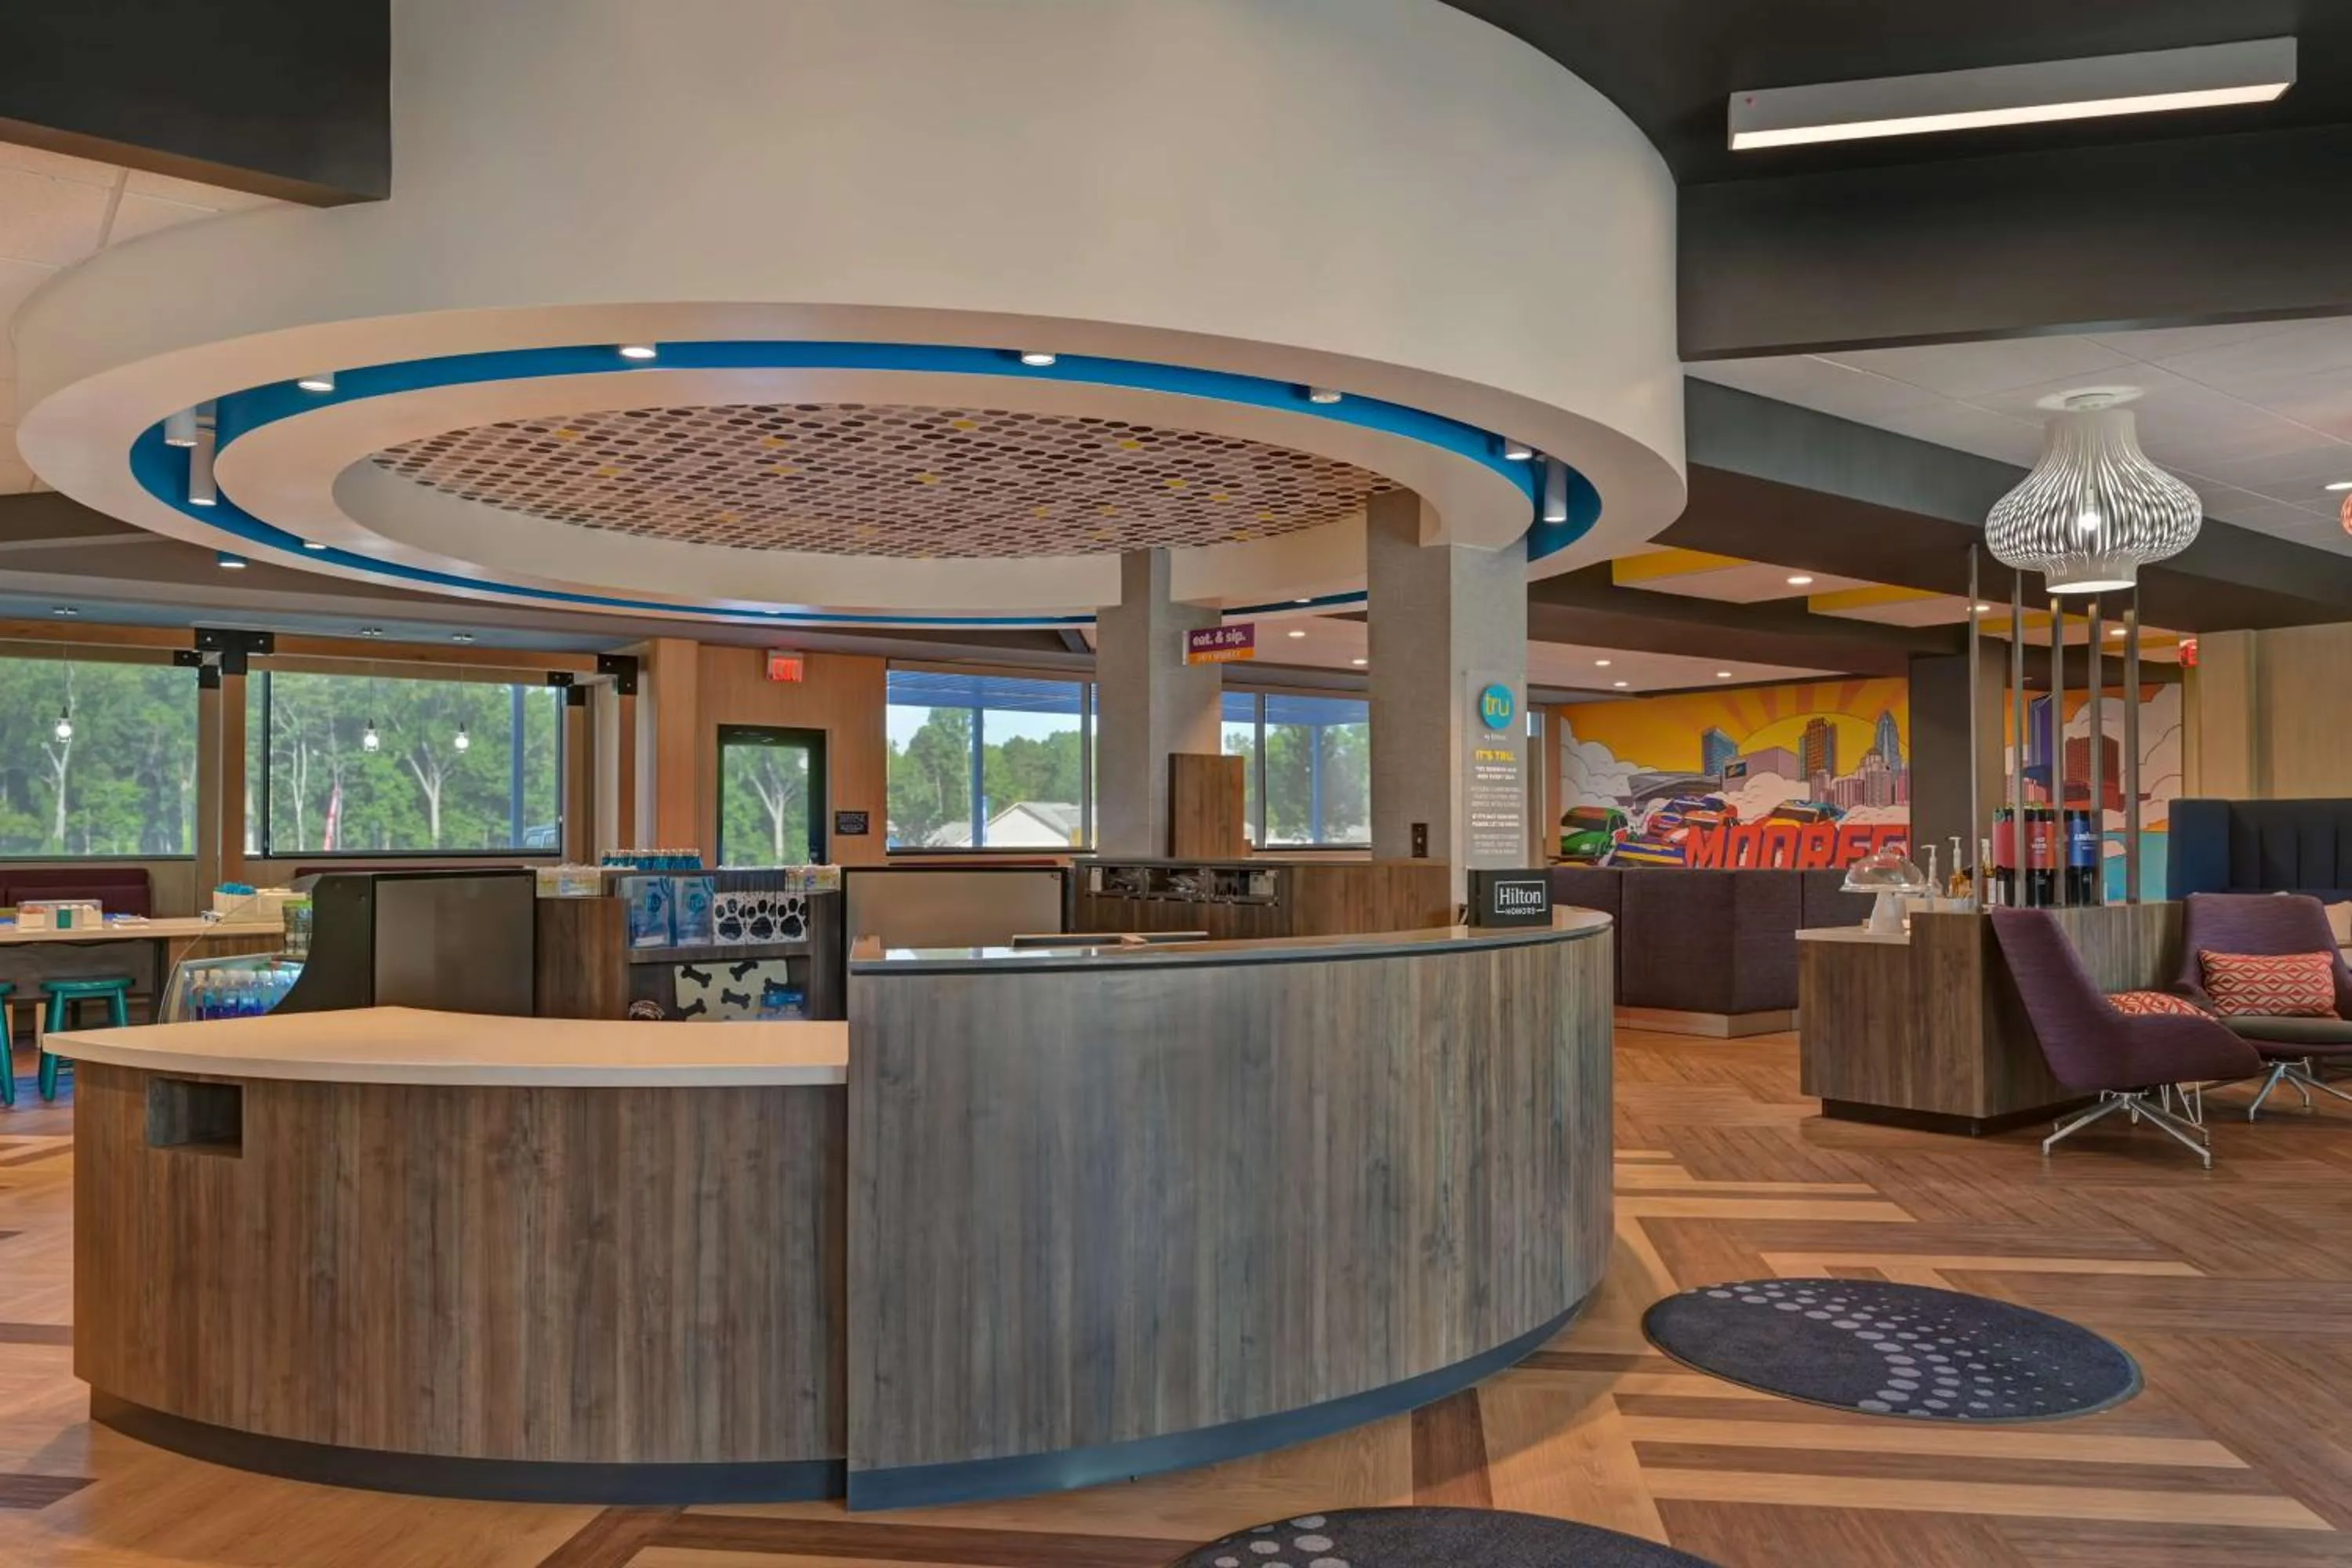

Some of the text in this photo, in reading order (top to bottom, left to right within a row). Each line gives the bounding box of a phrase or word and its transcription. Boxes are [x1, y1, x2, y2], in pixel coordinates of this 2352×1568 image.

[1192, 628, 1246, 646] eat. & sip.
[1485, 691, 1509, 717] tru
[1499, 887, 1542, 905] Hilton
